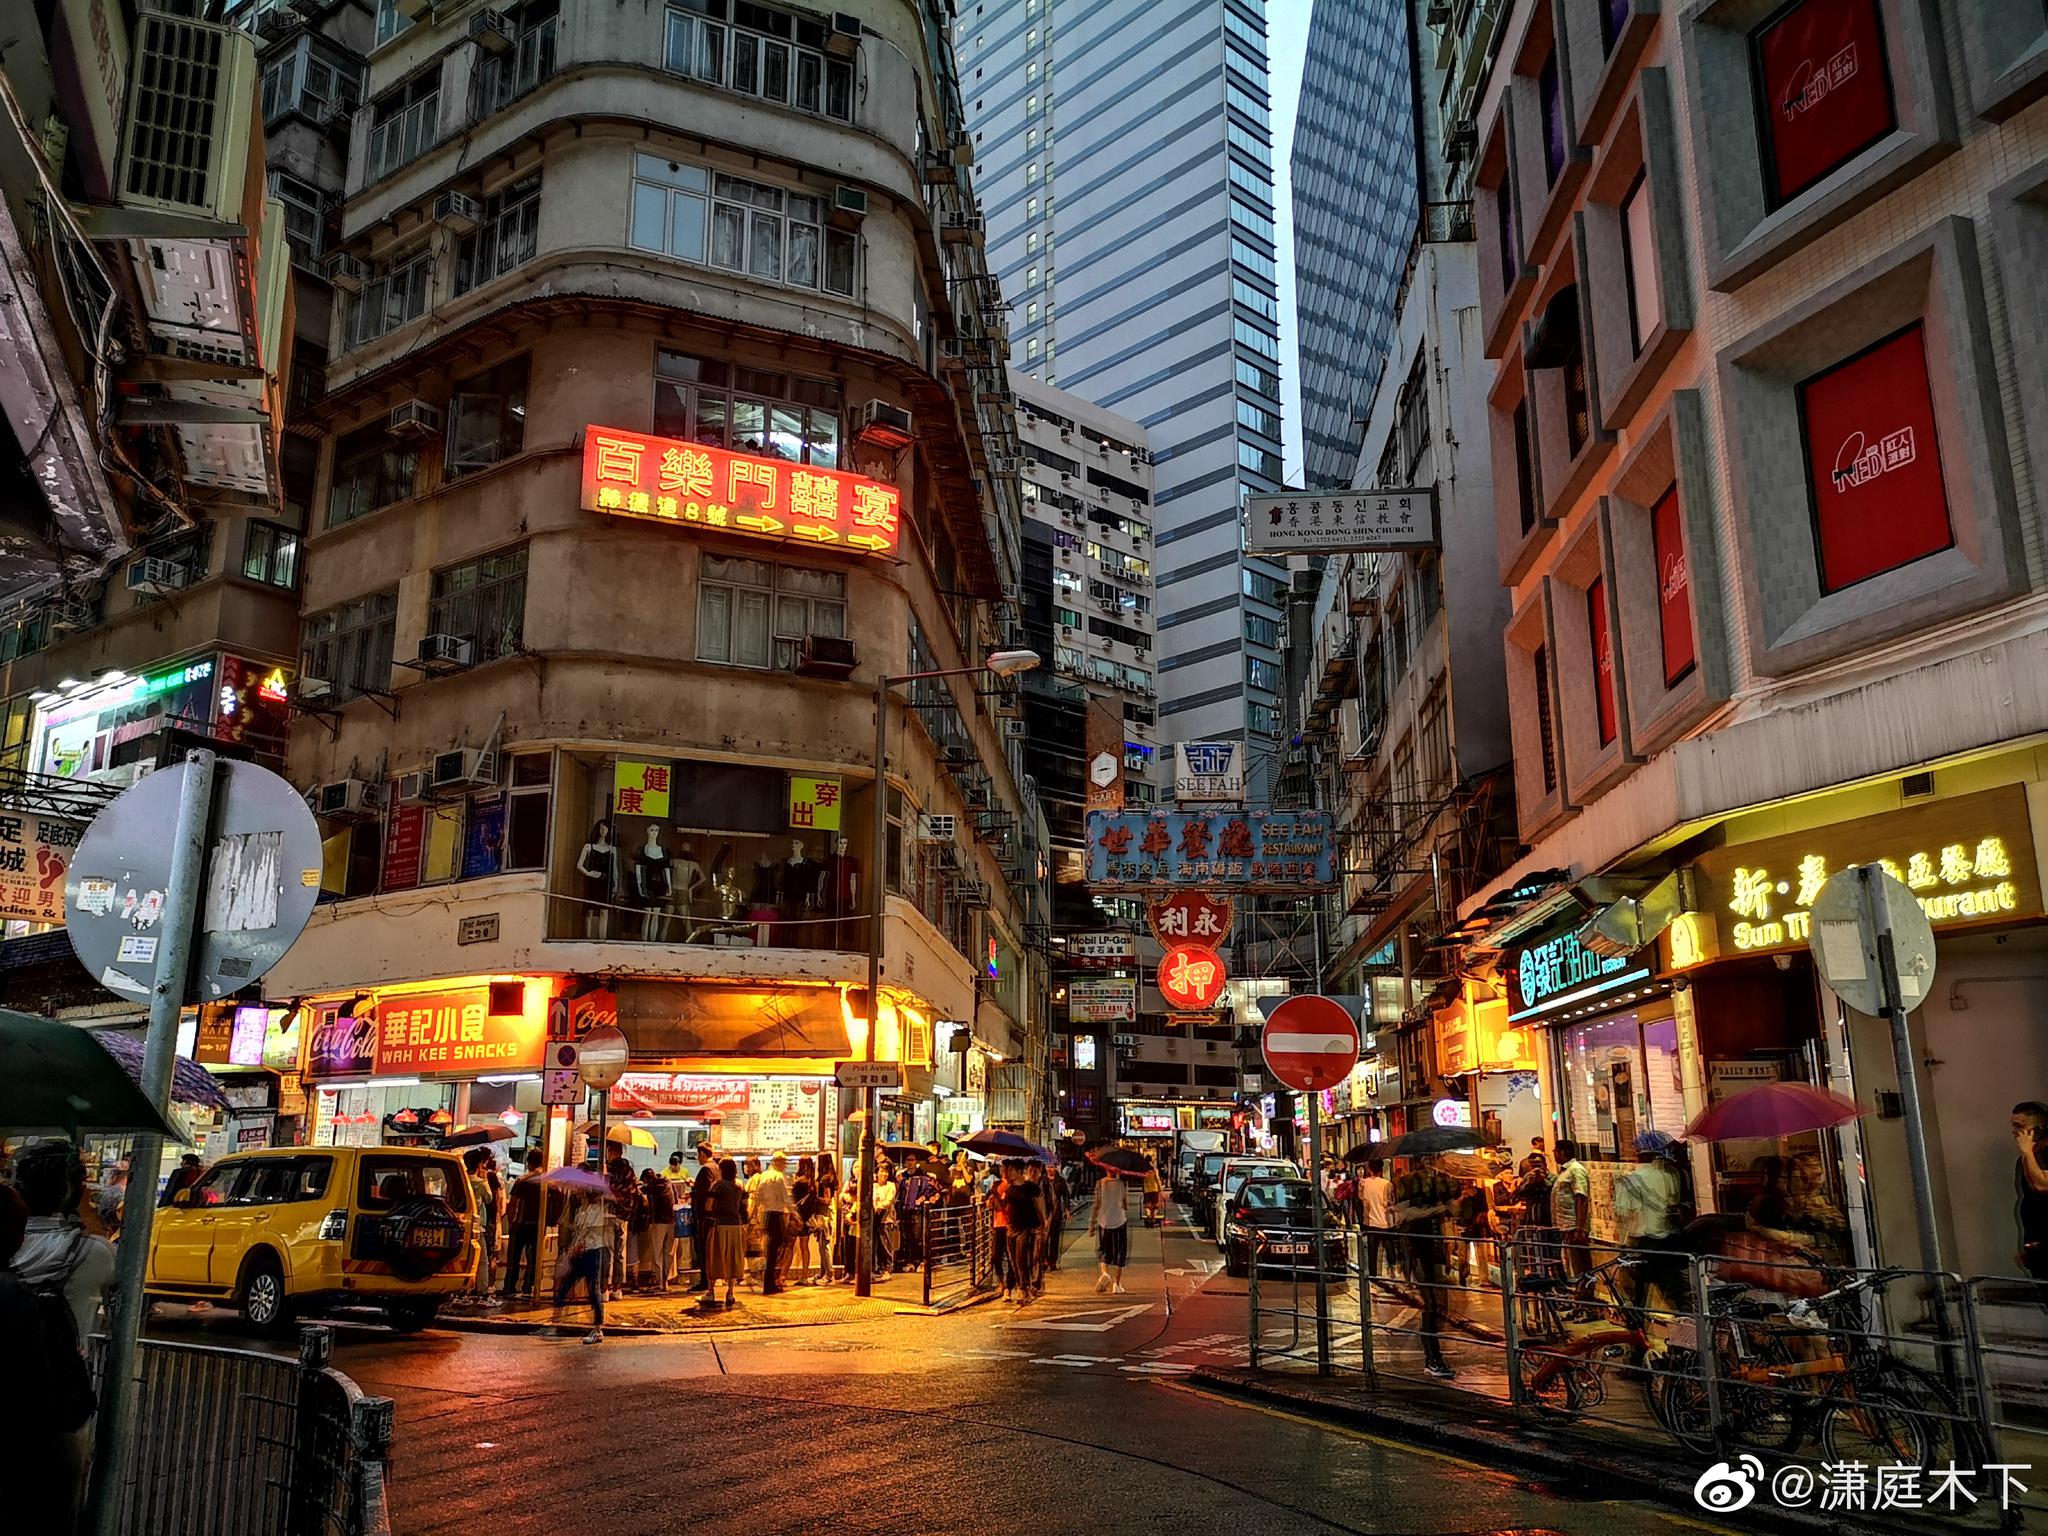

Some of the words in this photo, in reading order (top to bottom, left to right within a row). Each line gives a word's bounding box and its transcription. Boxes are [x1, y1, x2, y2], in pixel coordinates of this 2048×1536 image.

[1286, 497, 1413, 515] 홍콩동신교회
[1269, 528, 1297, 538] HONG
[1298, 528, 1323, 537] KONG
[1325, 527, 1351, 536] DONG
[1352, 526, 1374, 535] SHIN
[1376, 525, 1415, 534] CHURCH
[617, 766, 668, 814] 健康
[1176, 777, 1206, 791] SEE
[1209, 776, 1241, 791] FAH
[1262, 823, 1288, 837] SEE
[1293, 823, 1323, 836] FAH
[1262, 843, 1322, 857] RESTAURANT
[42, 909, 57, 918] &
[1071, 936, 1097, 945] Mobil
[1098, 935, 1132, 945] LP-Gas
[1733, 921, 1783, 950] Sun
[1168, 953, 1216, 1001] 押
[202, 1026, 230, 1035] HAIR
[383, 1003, 487, 1047] 華記小食
[382, 1050, 413, 1064] WAH
[418, 1047, 447, 1062] KEE
[453, 1042, 518, 1060] SNACKS
[870, 1064, 896, 1072] Avenue
[571, 1072, 579, 1084] 7
[570, 1090, 578, 1102] 7
